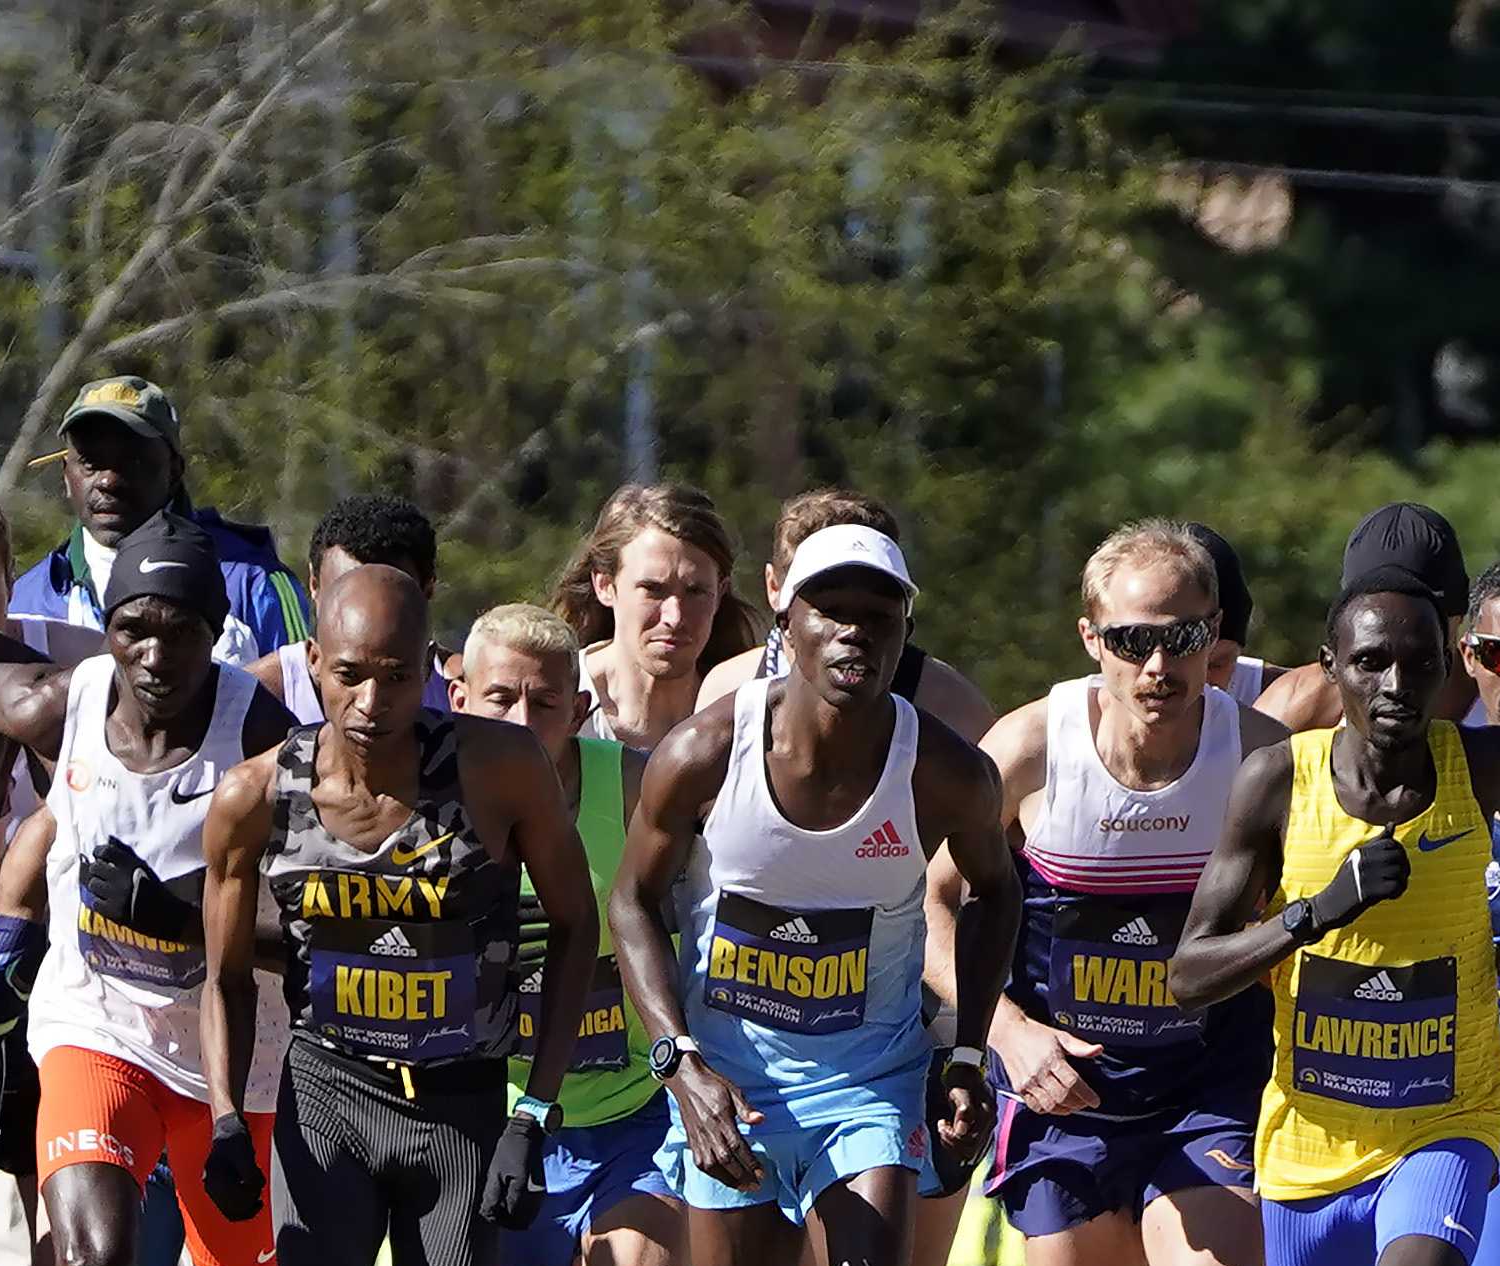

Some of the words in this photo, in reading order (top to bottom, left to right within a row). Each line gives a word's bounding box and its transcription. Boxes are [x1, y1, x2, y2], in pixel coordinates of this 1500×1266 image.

[1100, 815, 1190, 832] saucony
[302, 872, 451, 919] ARMY
[709, 935, 867, 999] BENSON
[336, 965, 452, 1020] KIBET
[1101, 1016, 1145, 1027] BOSTON
[1296, 1011, 1454, 1060] LAWRENCE
[1323, 1081, 1391, 1098] MARATHON
[1347, 1076, 1391, 1089] BOSTON
[47, 1129, 135, 1167] INEOS
